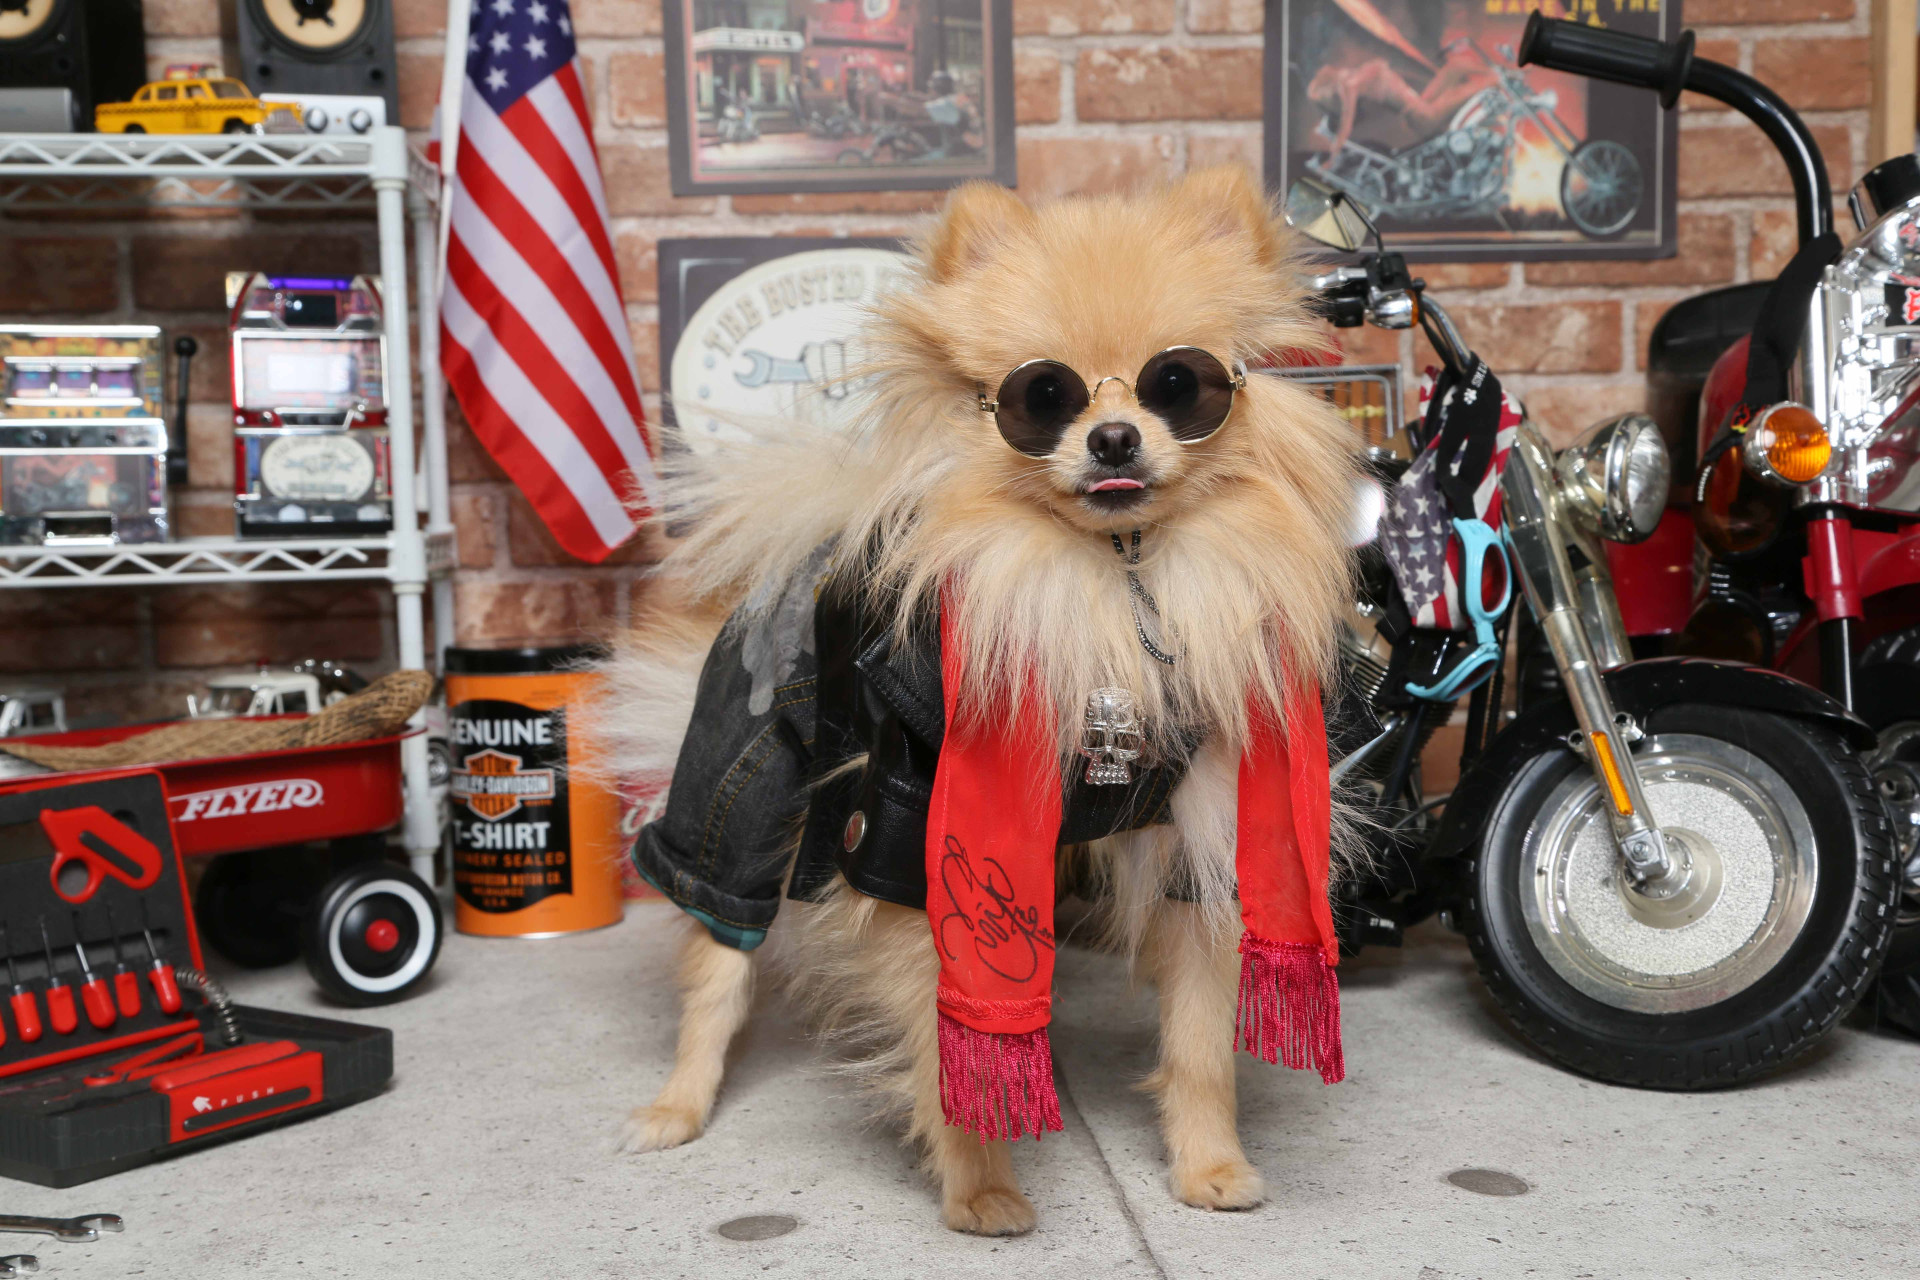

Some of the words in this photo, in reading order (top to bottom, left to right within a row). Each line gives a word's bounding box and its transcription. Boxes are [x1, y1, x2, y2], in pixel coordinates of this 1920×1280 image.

[1486, 0, 1555, 14] MADE
[1570, 0, 1598, 13] IN
[1615, 0, 1660, 13] THE
[704, 295, 762, 357] THE
[761, 265, 865, 317] BUSTED
[177, 778, 324, 822] FLYER
[453, 820, 551, 849] T-SHIRT
[503, 850, 566, 868] SEALED
[221, 1086, 275, 1107] PUSH
